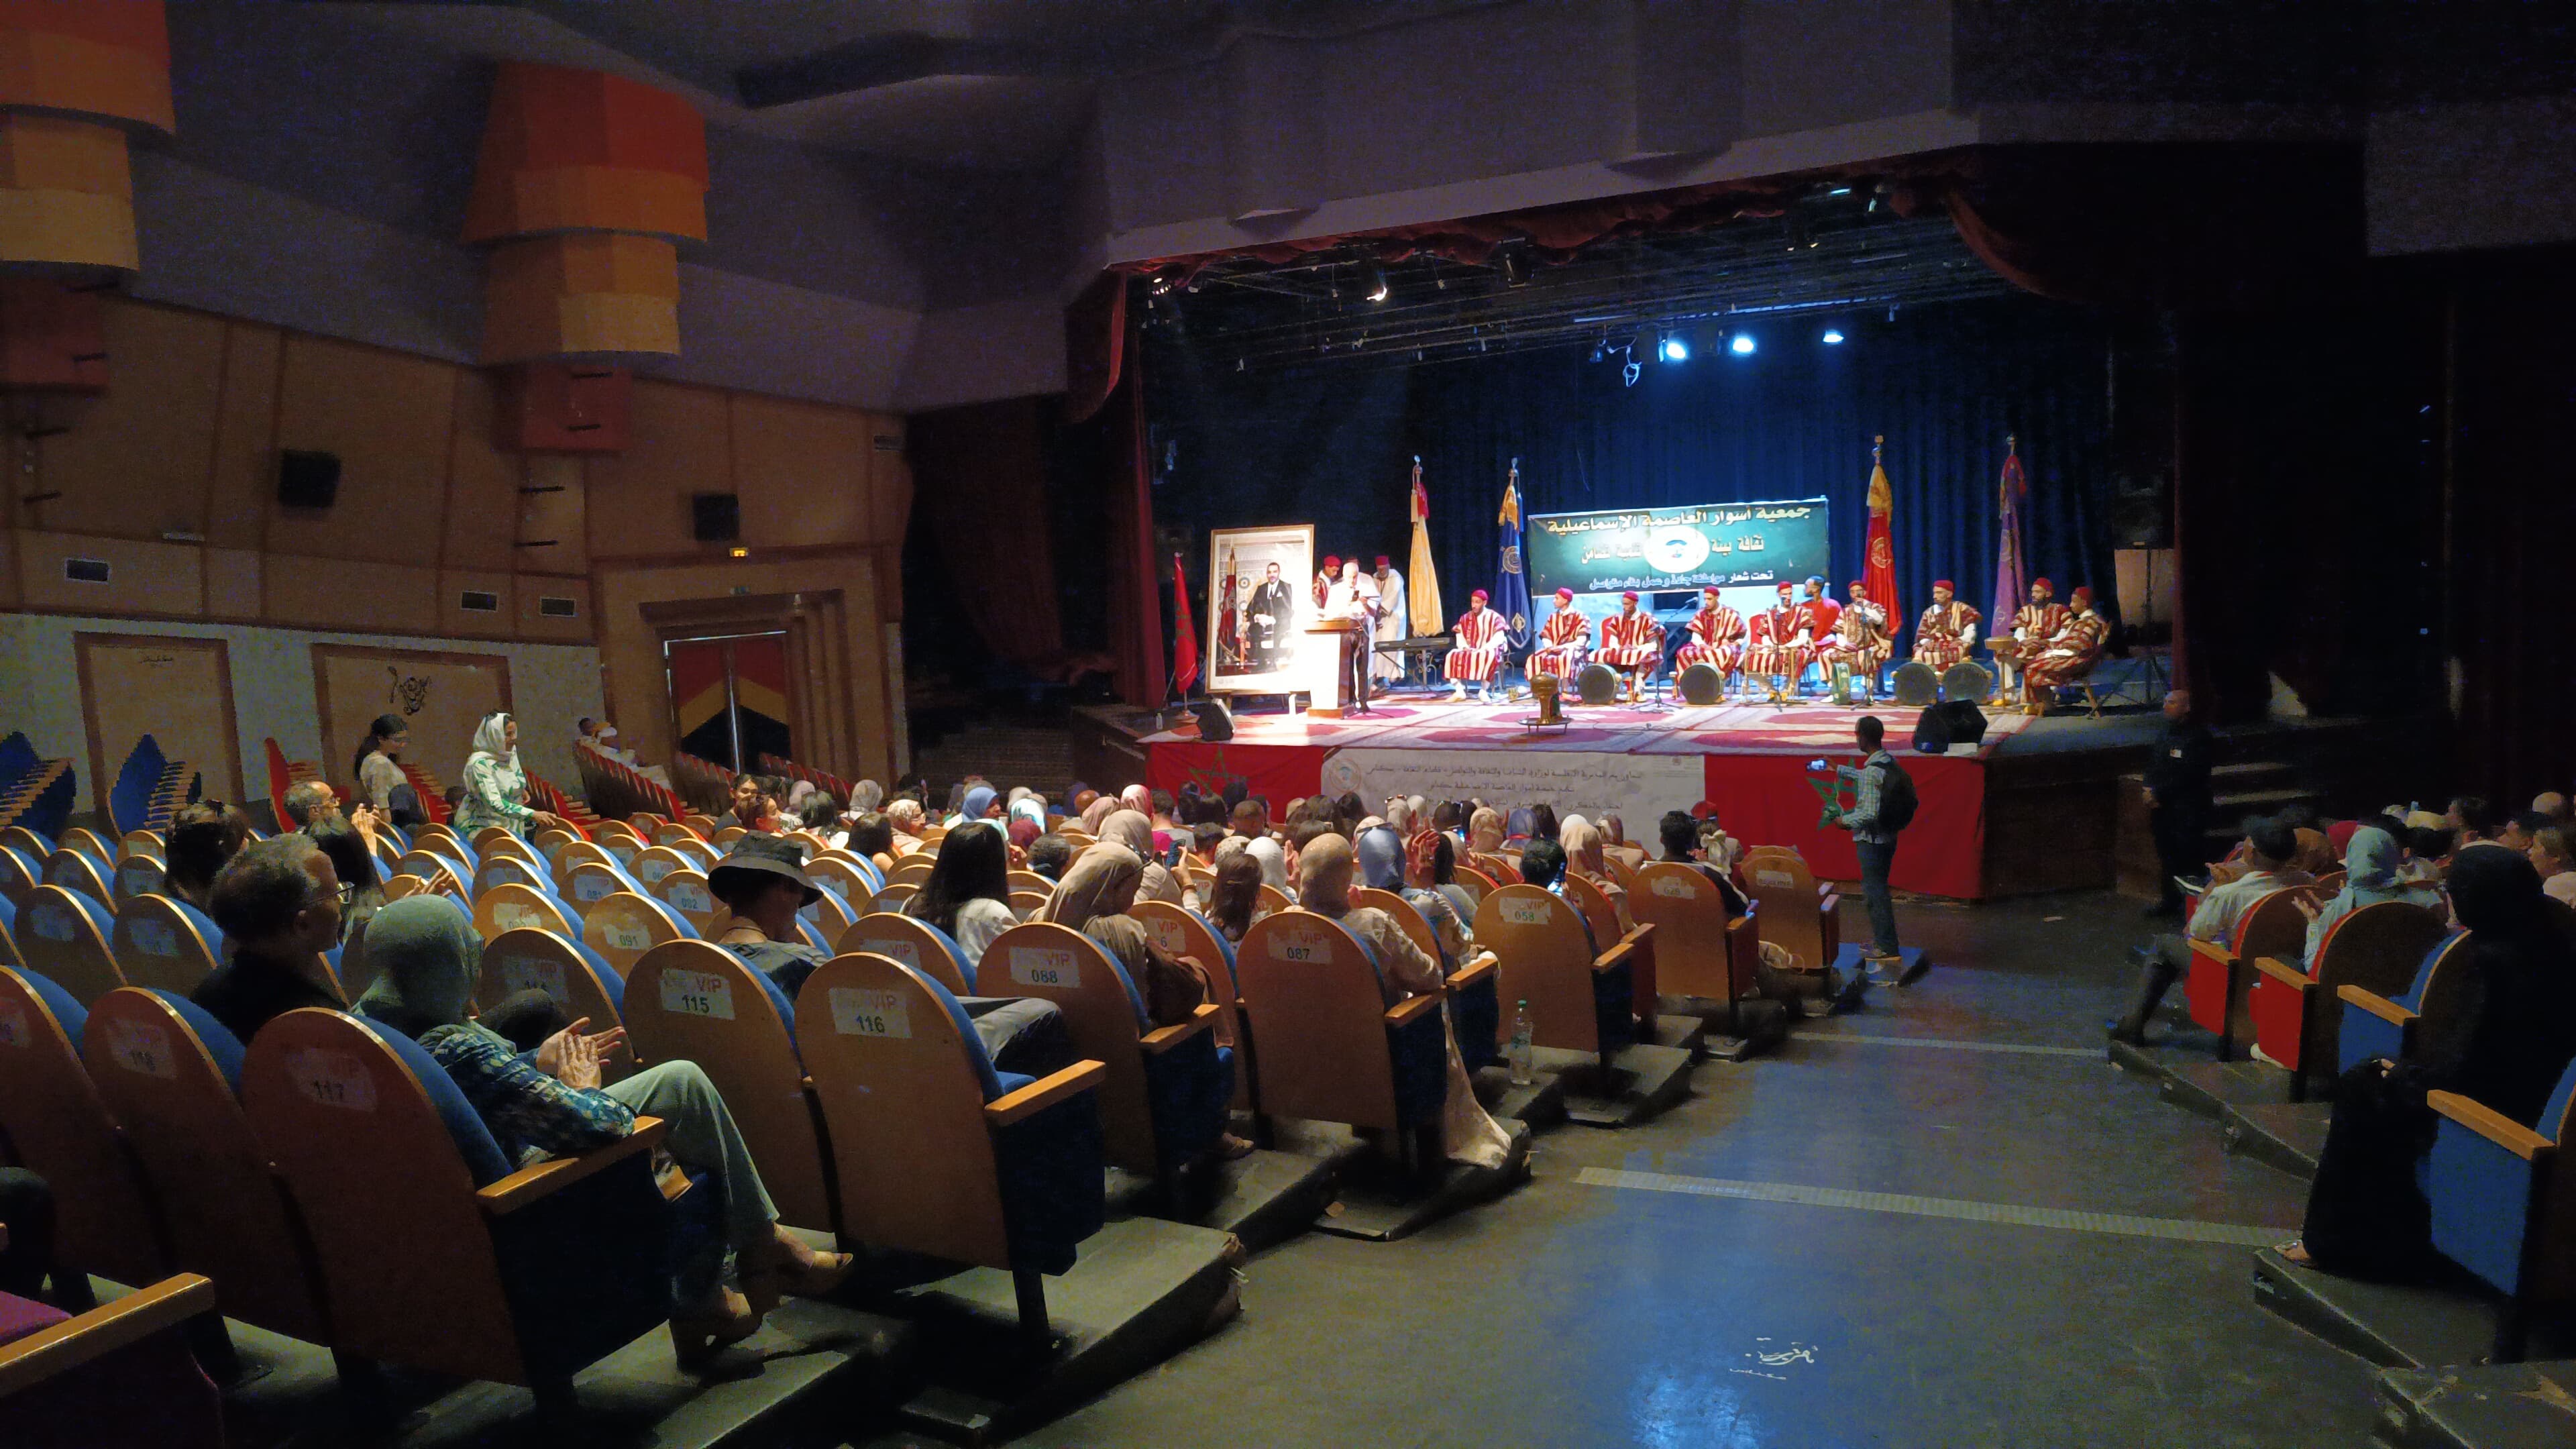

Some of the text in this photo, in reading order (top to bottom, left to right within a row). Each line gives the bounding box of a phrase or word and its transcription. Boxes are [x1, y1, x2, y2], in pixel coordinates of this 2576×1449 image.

[1642, 510, 1707, 527] العاصمة
[1755, 506, 1811, 523] جمعية
[1547, 515, 1638, 535] الإسماعيلية
[1737, 534, 1764, 551] ثقافة
[1727, 570, 1750, 584] شعار
[1750, 570, 1774, 581] تحت
[1514, 910, 1536, 922] 058
[1158, 921, 1179, 934] VIP
[890, 944, 911, 957] VIP
[1287, 947, 1311, 960] 087
[1046, 953, 1070, 967] VIP
[1031, 968, 1059, 983] 088
[695, 975, 722, 994] VIP
[682, 994, 710, 1014] 115
[856, 1015, 886, 1034] 116
[310, 1079, 345, 1100] 117
